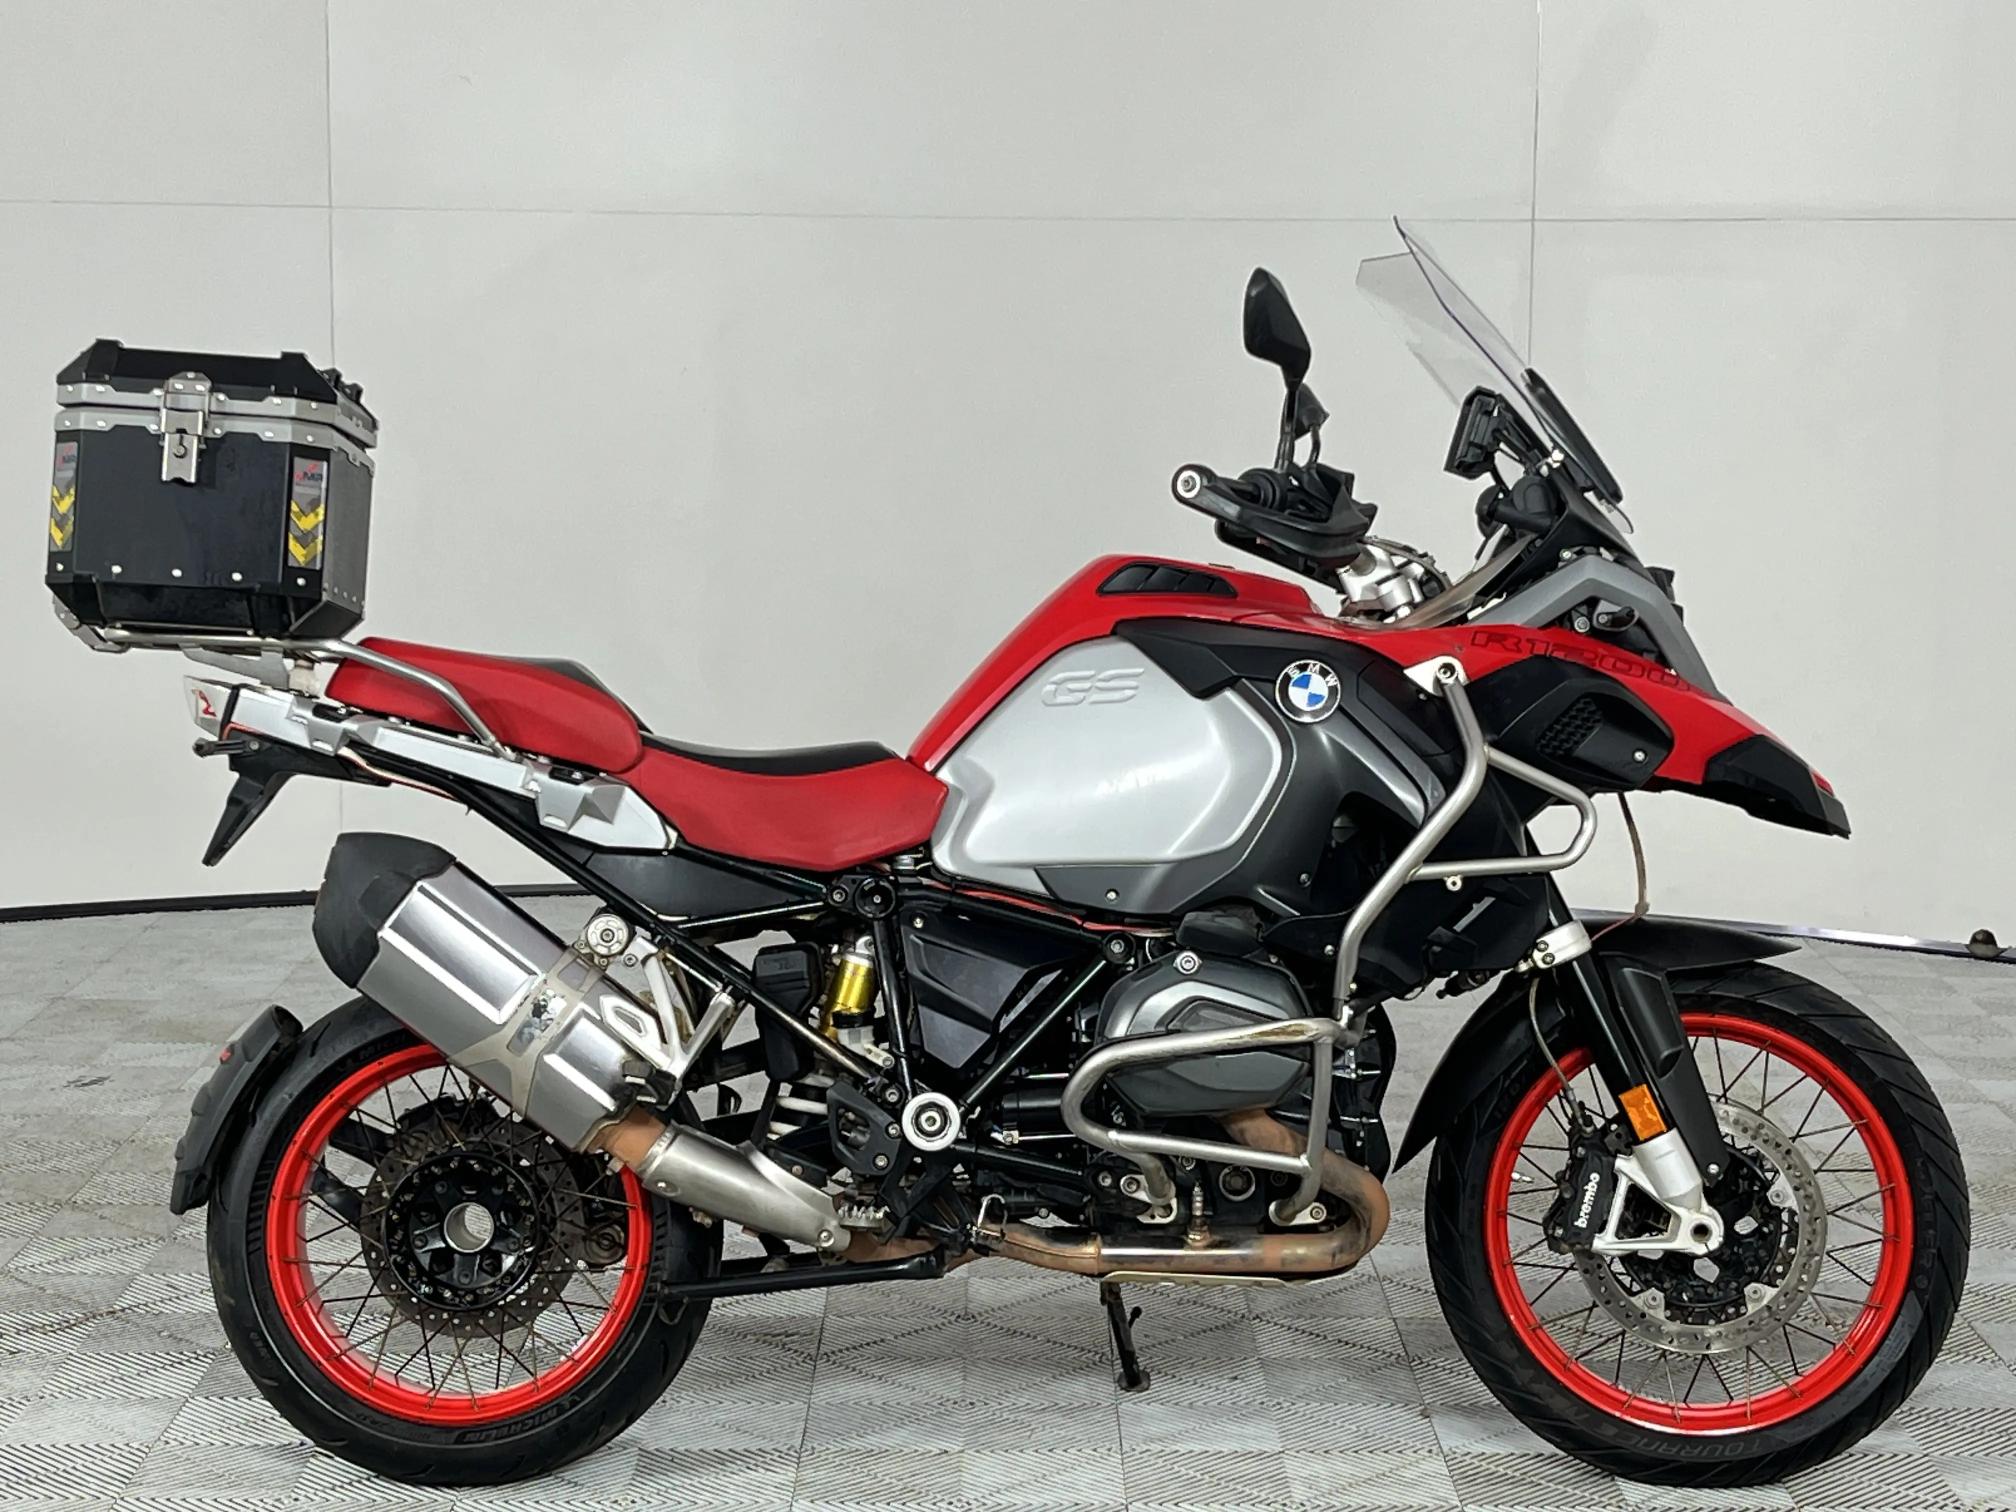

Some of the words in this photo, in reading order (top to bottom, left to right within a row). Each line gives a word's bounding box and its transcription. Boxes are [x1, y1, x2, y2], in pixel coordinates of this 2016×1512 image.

[1041, 667, 1145, 708] GS
[1286, 662, 1338, 687] BMW
[1573, 1172, 1600, 1229] brembo
